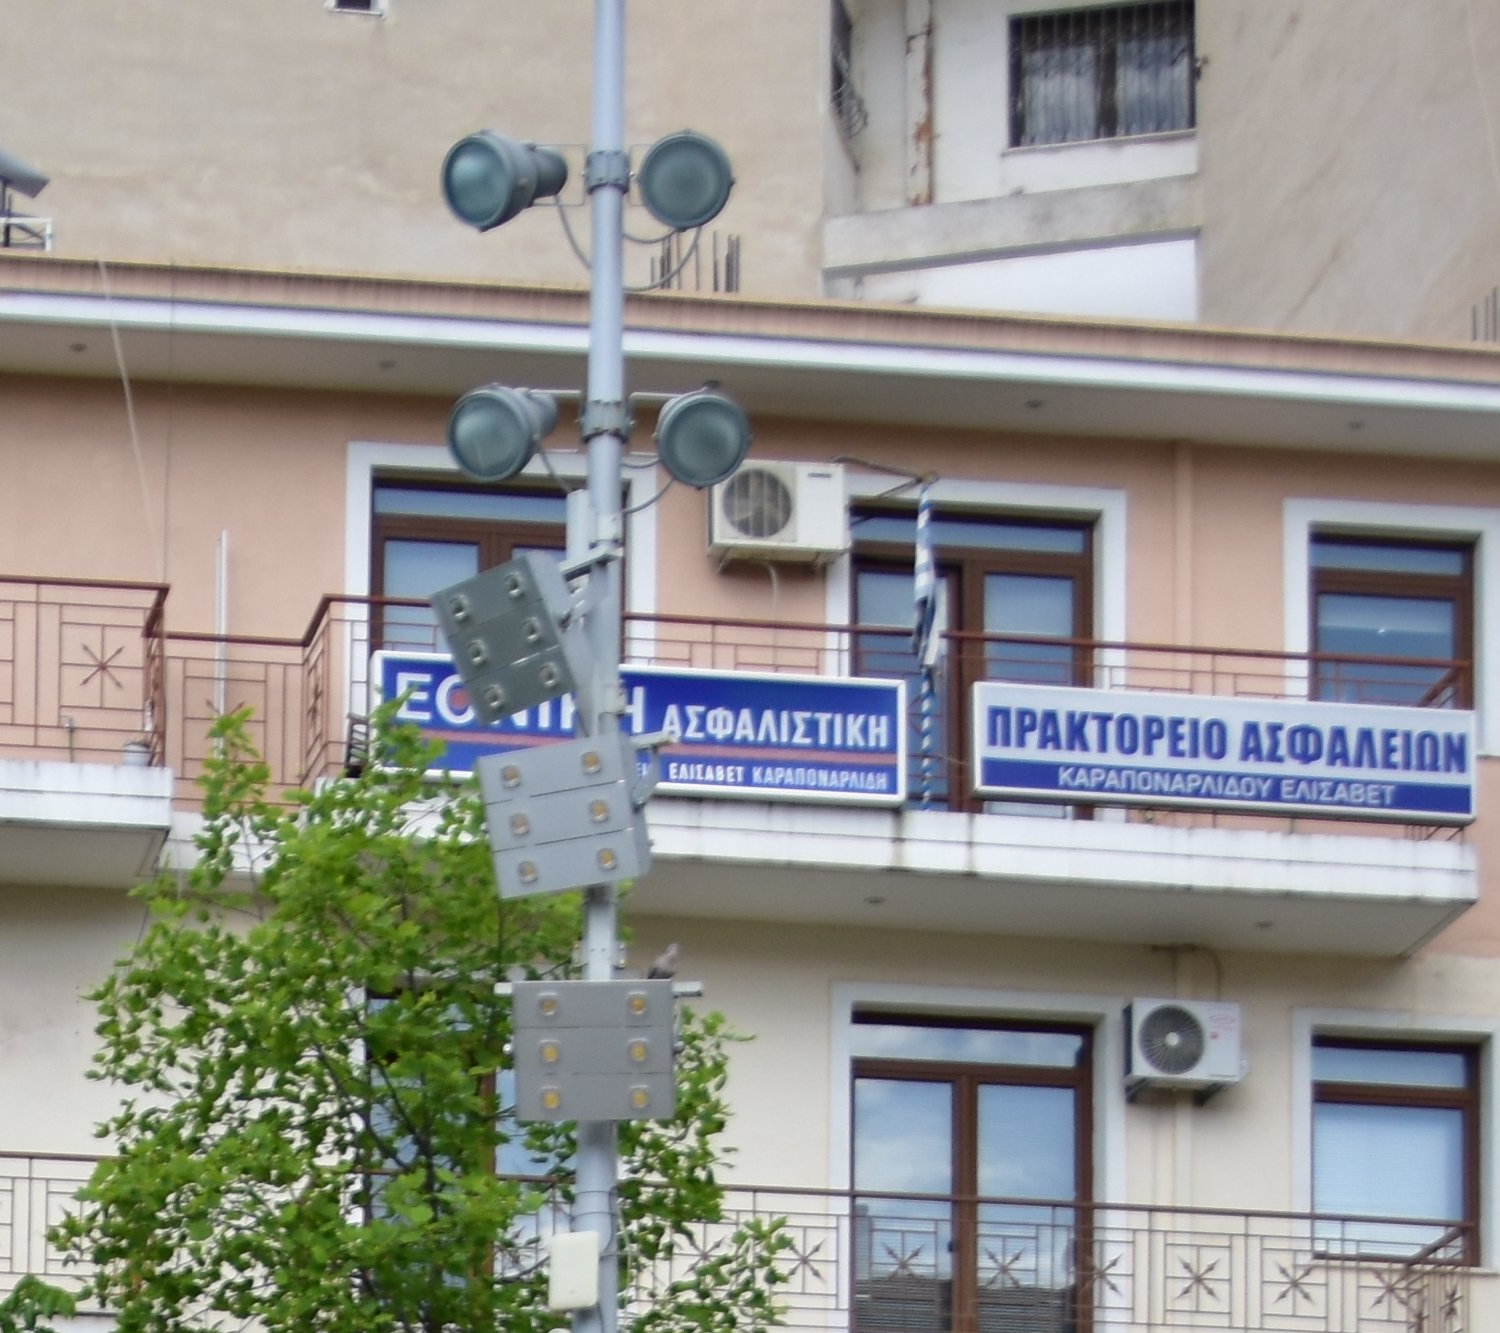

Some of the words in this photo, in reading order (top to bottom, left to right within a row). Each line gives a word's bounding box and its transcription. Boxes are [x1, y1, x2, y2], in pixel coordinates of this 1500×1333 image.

[662, 703, 889, 750] ΑΣΦΑΛΙΣΤΙΚΗ
[985, 705, 1228, 762] ΠΡΑΚΤΟΡΕΙΟ
[1239, 720, 1467, 774] ΑΣΦΑΛΕΙΩΝ
[669, 761, 745, 784] ΕΛΙΣΑΒΕΤ
[1057, 765, 1273, 799] ΚΑΡΑΠΟΝΑΡΛΙΔΟΥ
[1279, 779, 1397, 807] ΕΛΙΣΑΒΕΤ
